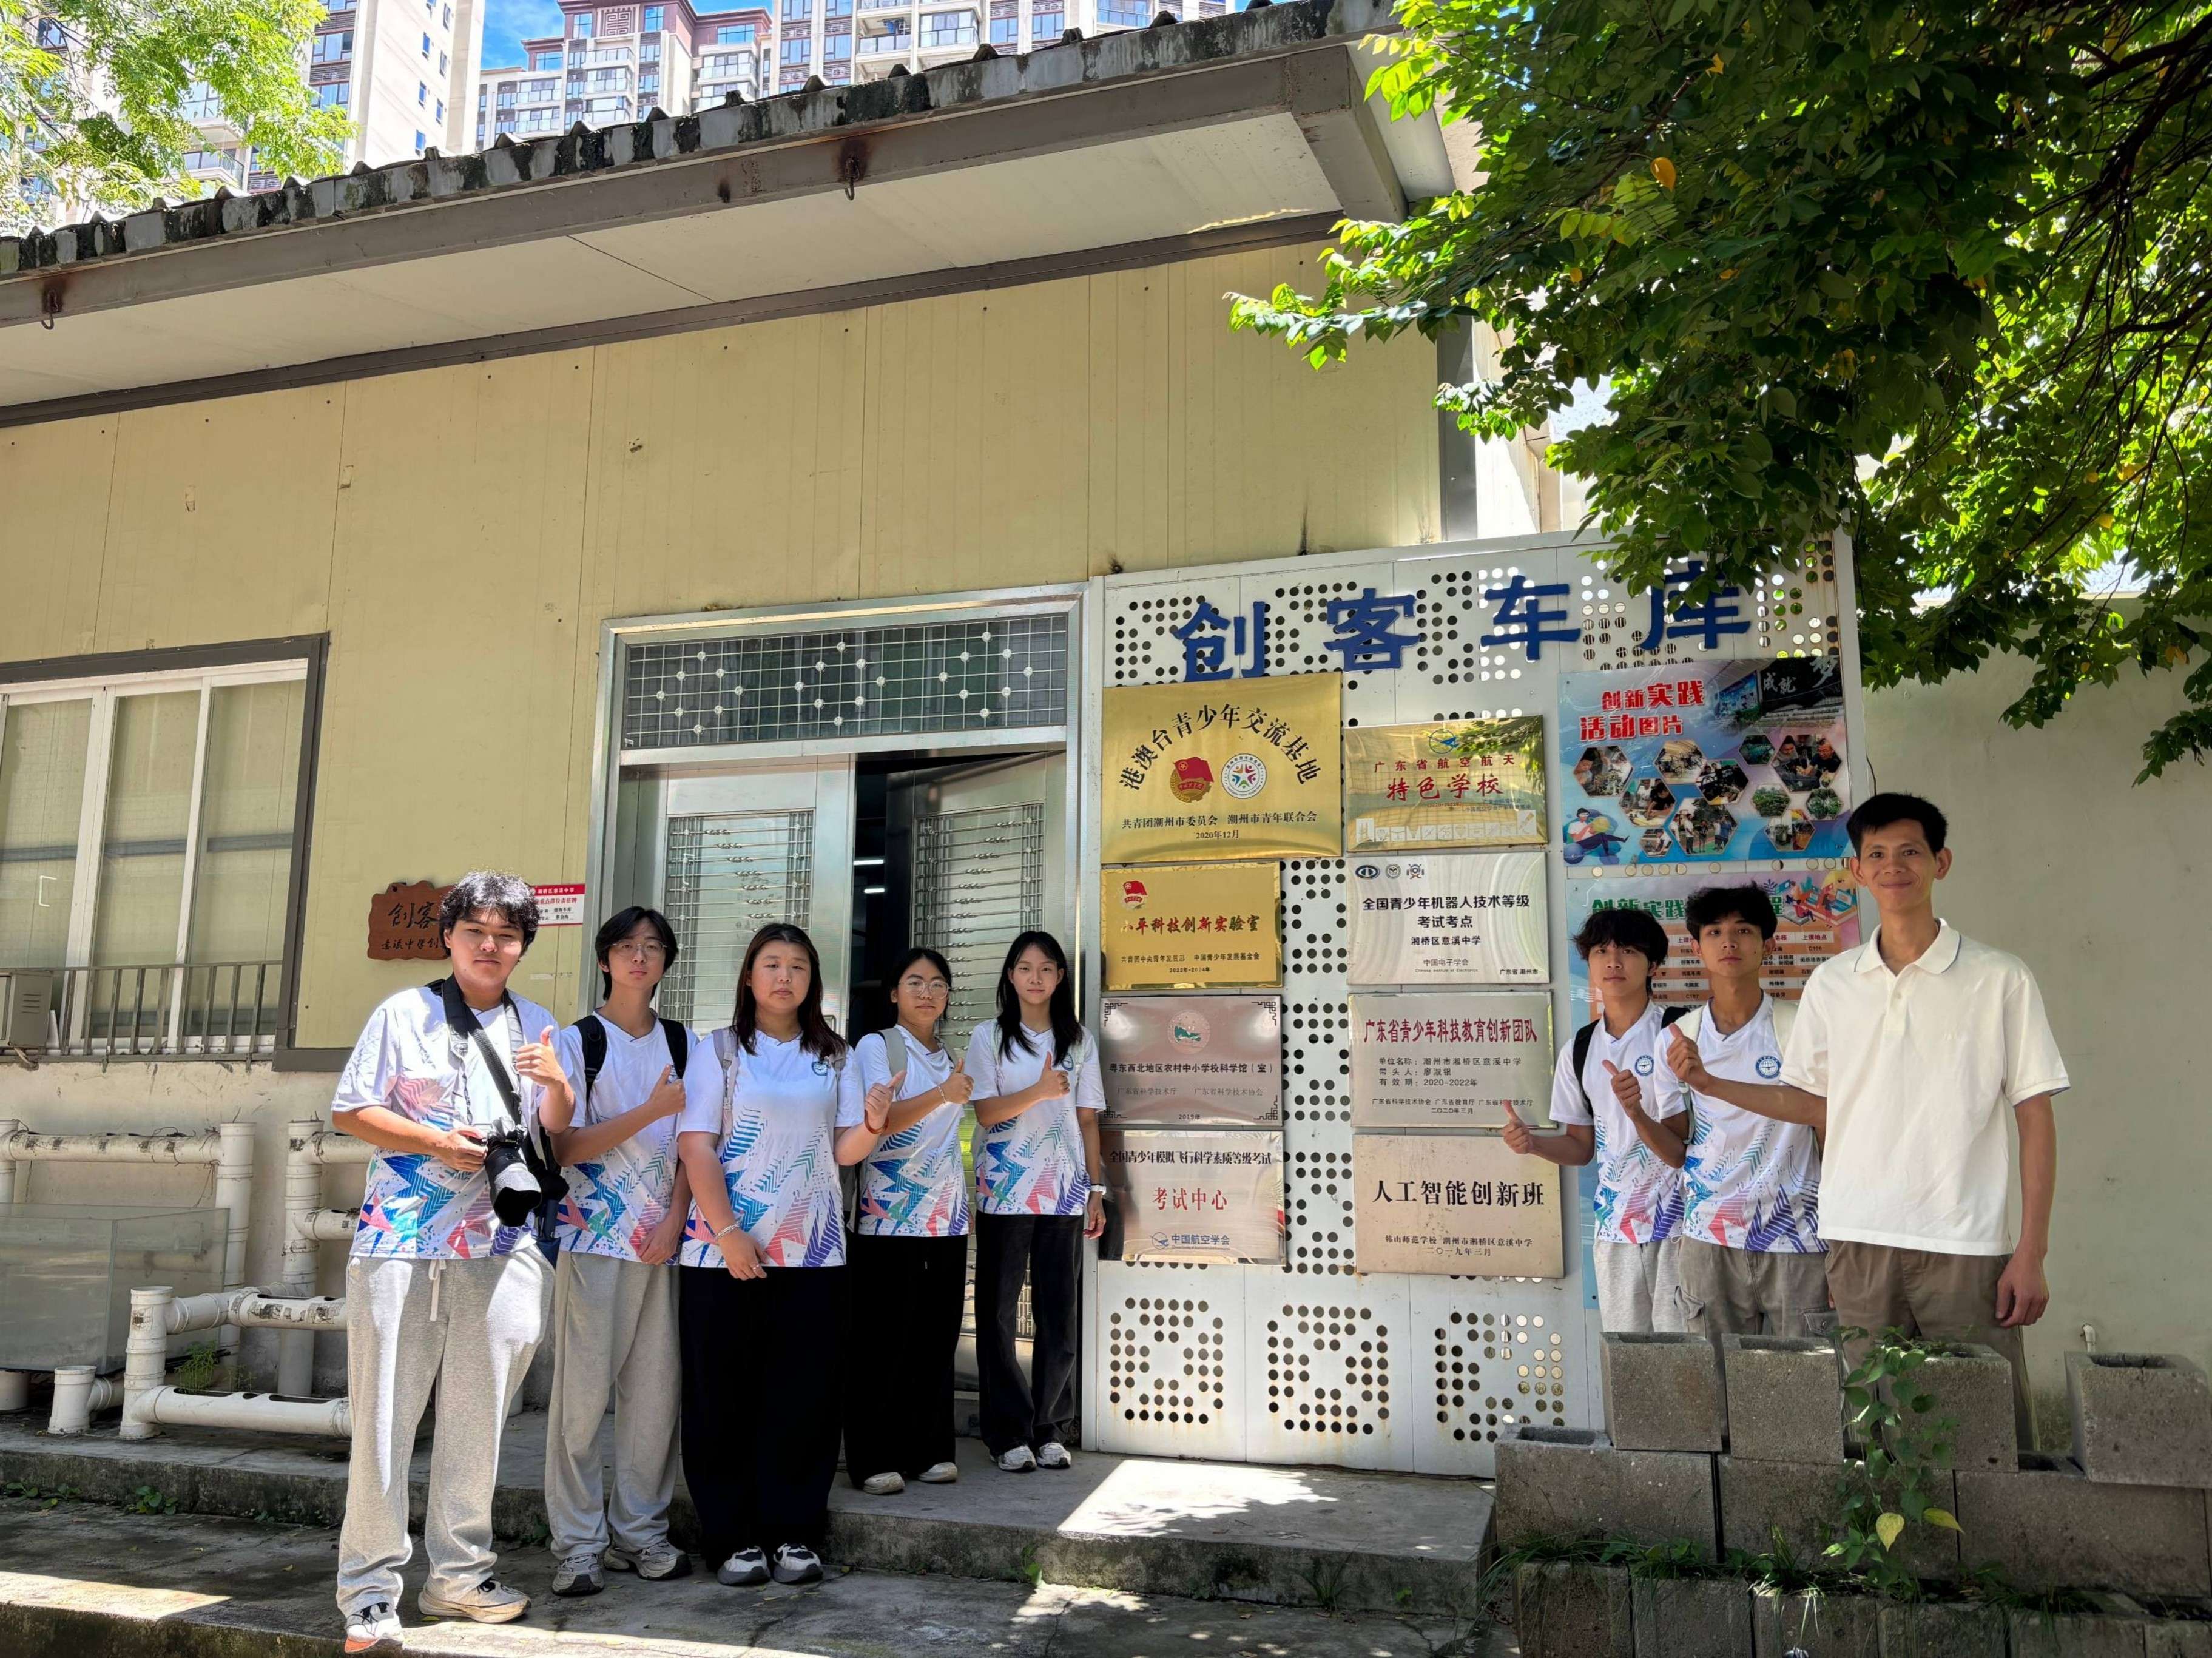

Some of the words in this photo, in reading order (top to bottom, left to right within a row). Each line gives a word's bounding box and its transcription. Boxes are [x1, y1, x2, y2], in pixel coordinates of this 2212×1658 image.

[1173, 559, 1752, 682] 创客车库
[1600, 679, 1705, 712] 创新实践
[1579, 713, 1684, 742] 活动图片
[1119, 703, 1321, 790] 港澳台青少年交流基地
[1374, 754, 1516, 773] 广东省航空航天
[1386, 773, 1504, 802] 特色学校
[1121, 814, 1218, 829] 共青团潮州市委员会
[1227, 810, 1318, 825] 潮州市青年联合会
[1195, 829, 1239, 839] 2020年12月
[1362, 894, 1530, 911] 全国青少年机器人技术等级
[1417, 915, 1474, 929] 考试考点
[1411, 935, 1481, 946] 湘桥区意溪中学
[1193, 952, 1260, 961] 中国青少年发展基金会
[1364, 1018, 1537, 1043] 广东省青少年科技教育创新团队
[1423, 1057, 1522, 1066] 潮州市湘桥区意溪中学
[1110, 1150, 1272, 1165] 全国青少年模拟飞行科学素质等级考试
[1152, 1187, 1228, 1211] 考试中心
[1372, 1180, 1545, 1208] 人工智能创新班
[1171, 1233, 1230, 1245] 中国航空学会
[1442, 1236, 1533, 1247] 潮州市湘桥区意溪中学
